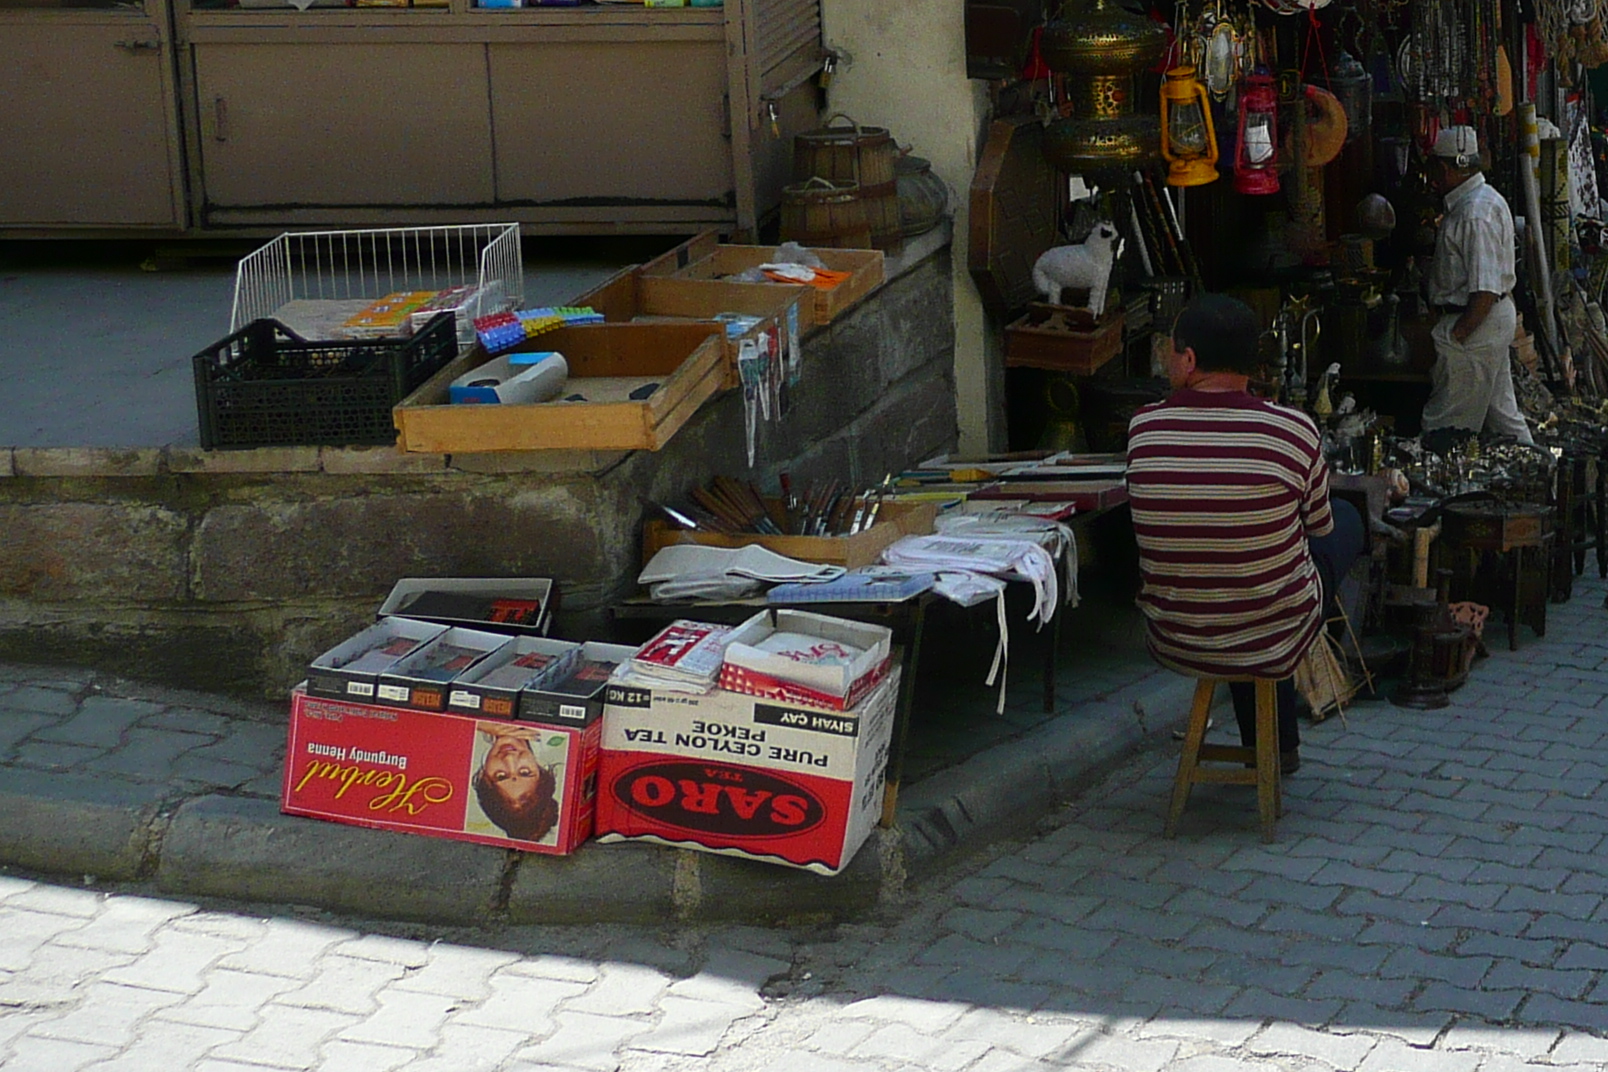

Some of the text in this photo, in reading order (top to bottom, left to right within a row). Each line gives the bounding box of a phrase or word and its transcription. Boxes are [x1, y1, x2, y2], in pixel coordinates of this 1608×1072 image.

[608, 688, 625, 702] KG
[692, 720, 766, 741] PEKOE
[780, 709, 854, 733] SİYAH ÇAY
[307, 741, 407, 769] Burgundy Henna
[624, 728, 828, 767] PURE CEYLON TEA
[703, 767, 744, 783] TEA
[630, 774, 809, 826] SARO
